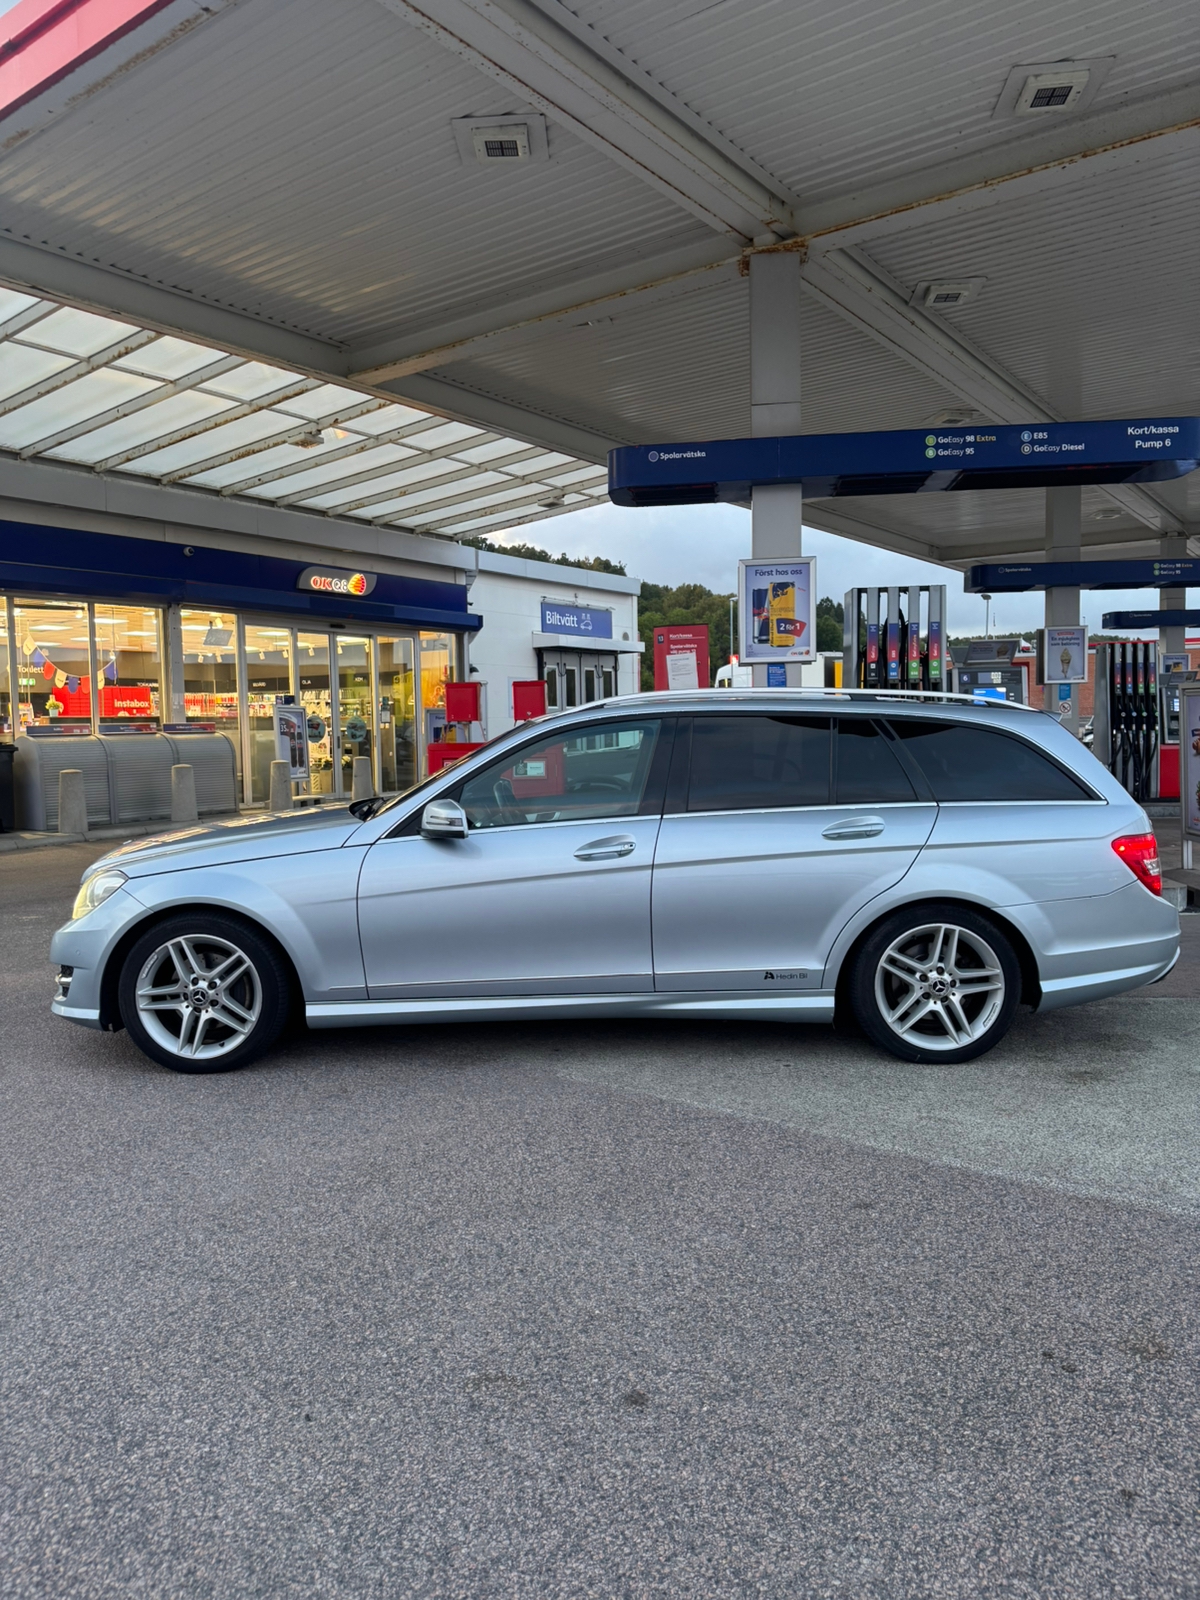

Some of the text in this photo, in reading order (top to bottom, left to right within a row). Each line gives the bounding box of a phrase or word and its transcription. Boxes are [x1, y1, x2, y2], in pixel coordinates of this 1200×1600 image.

[1127, 426, 1179, 435] Kort/kassa
[937, 436, 964, 444] GoEasy
[965, 435, 975, 443] 98
[1033, 432, 1048, 440] E85
[1033, 444, 1060, 453] GoEasy
[1061, 443, 1085, 451] Diesel
[1135, 438, 1172, 449] Pump 6
[660, 450, 706, 461] Spolarvätska
[937, 448, 964, 457] GoEasy
[754, 569, 774, 577] Först
[775, 568, 789, 576] hos
[310, 576, 348, 592] OKQ8
[545, 610, 578, 627] Biltvätt
[780, 623, 785, 631] 2
[795, 622, 800, 630] 1
